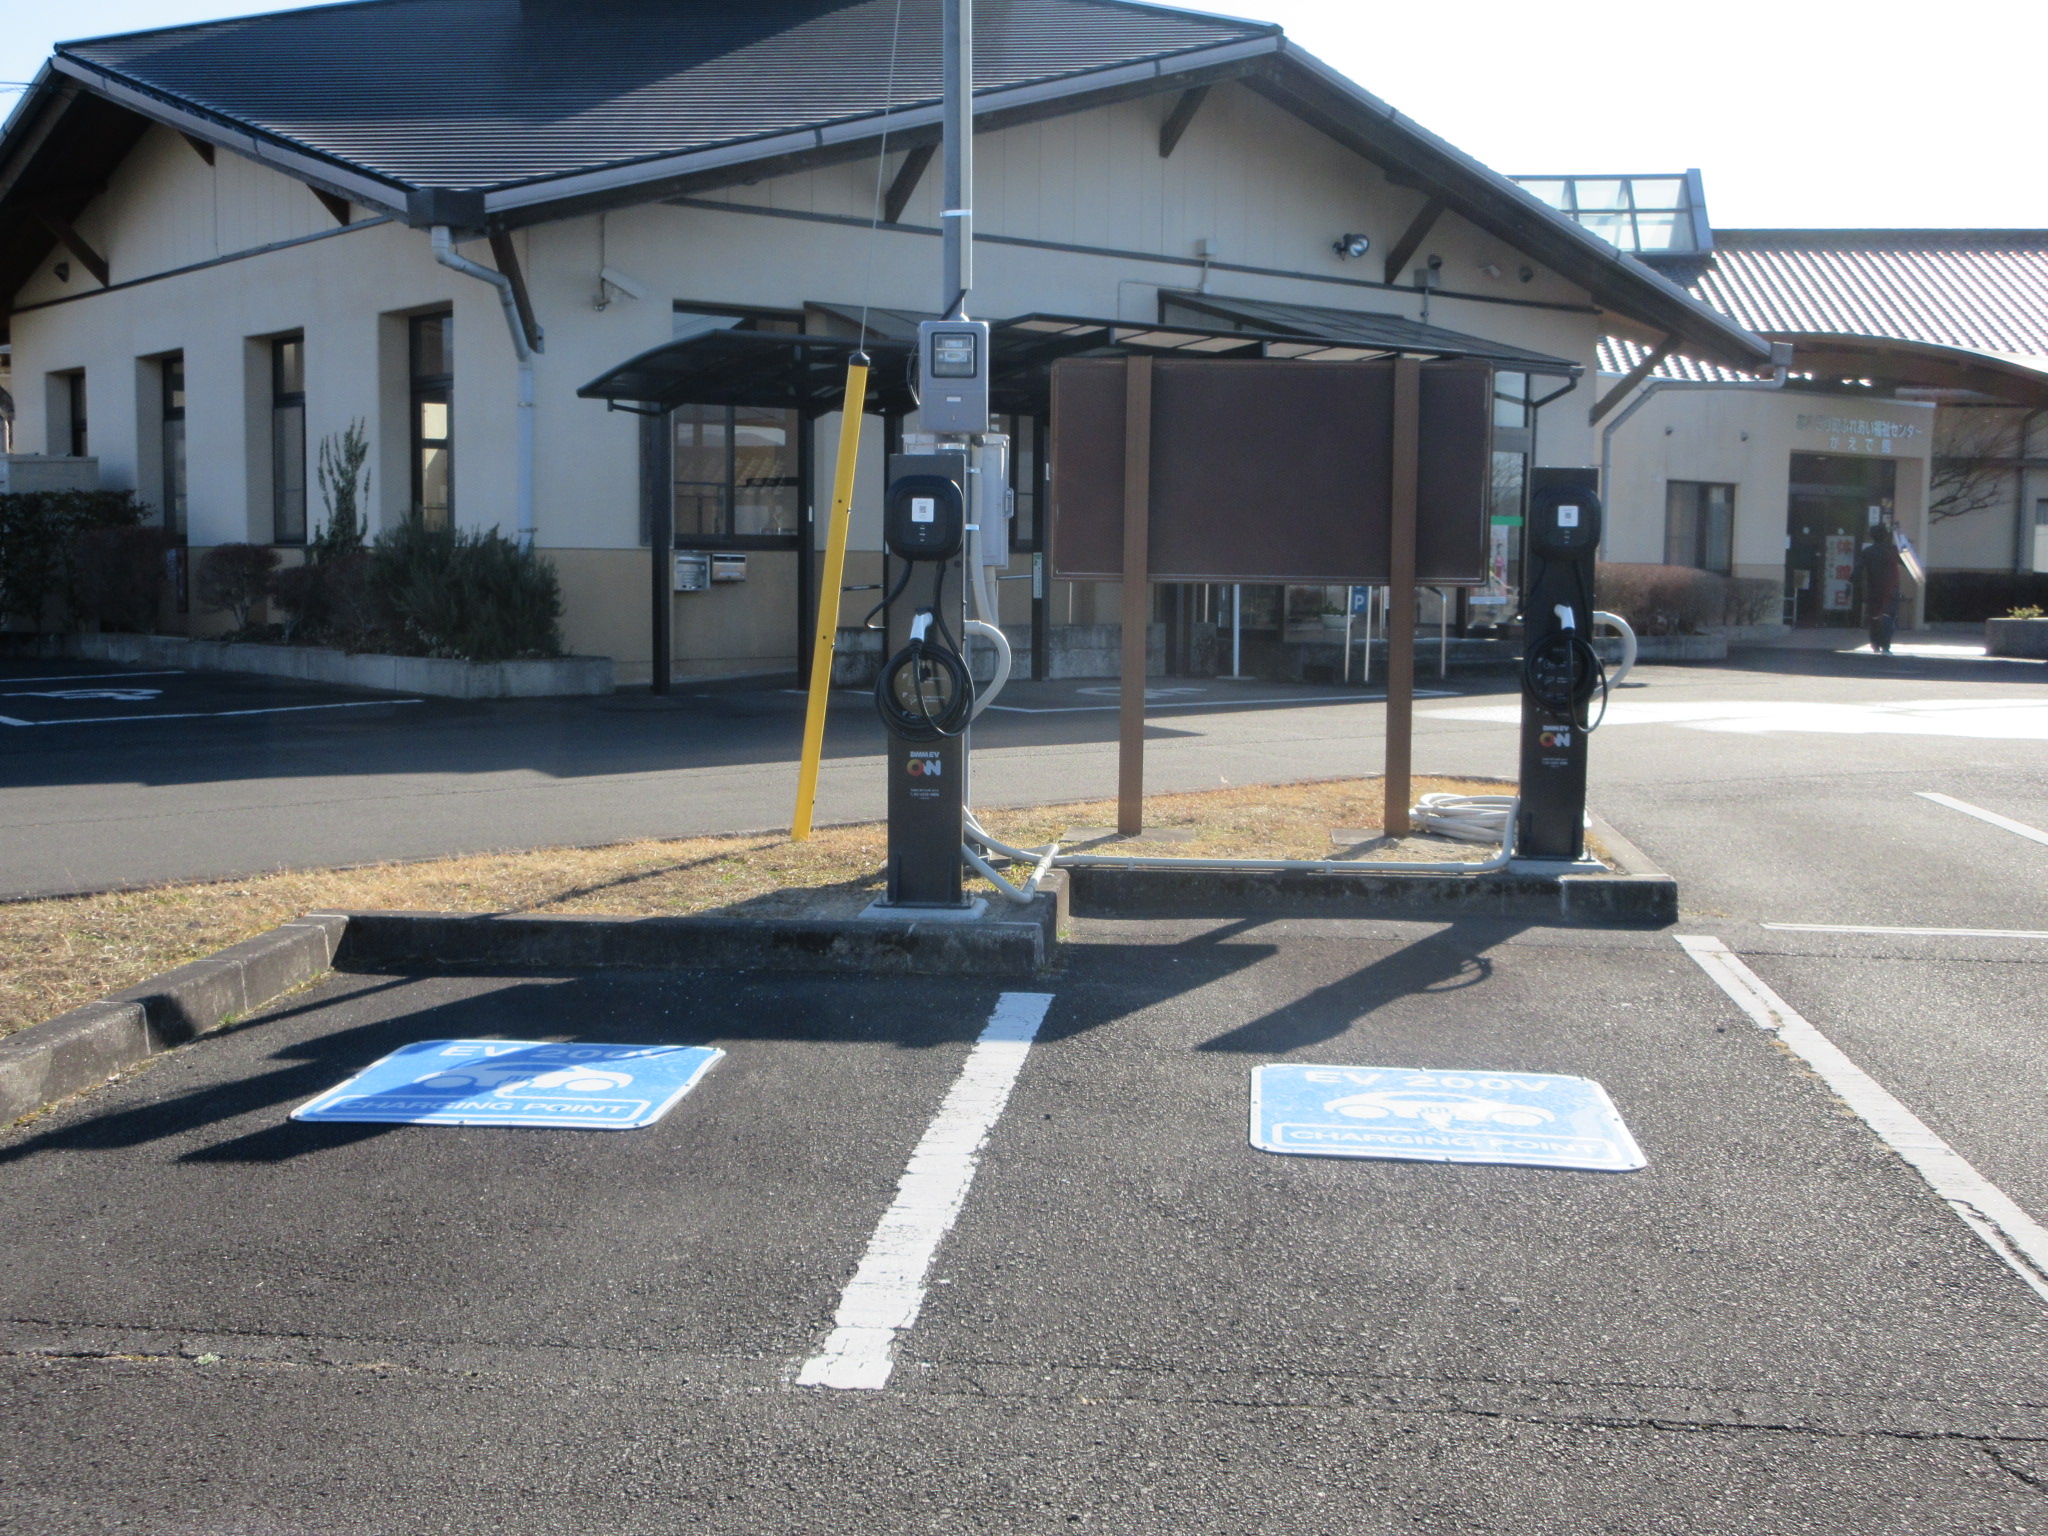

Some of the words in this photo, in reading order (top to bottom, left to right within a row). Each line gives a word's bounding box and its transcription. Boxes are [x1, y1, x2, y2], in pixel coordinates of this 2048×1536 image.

[1354, 594, 1365, 610] P
[1540, 732, 1571, 747] ON
[907, 759, 942, 776] ON
[439, 1046, 522, 1057] EV
[1305, 1071, 1382, 1086] EV
[1403, 1075, 1550, 1092] 200V
[340, 1101, 513, 1112] CHARGING
[521, 1102, 632, 1114] POINT
[1290, 1130, 1473, 1146] CHARGING
[1488, 1137, 1598, 1153] POINT
